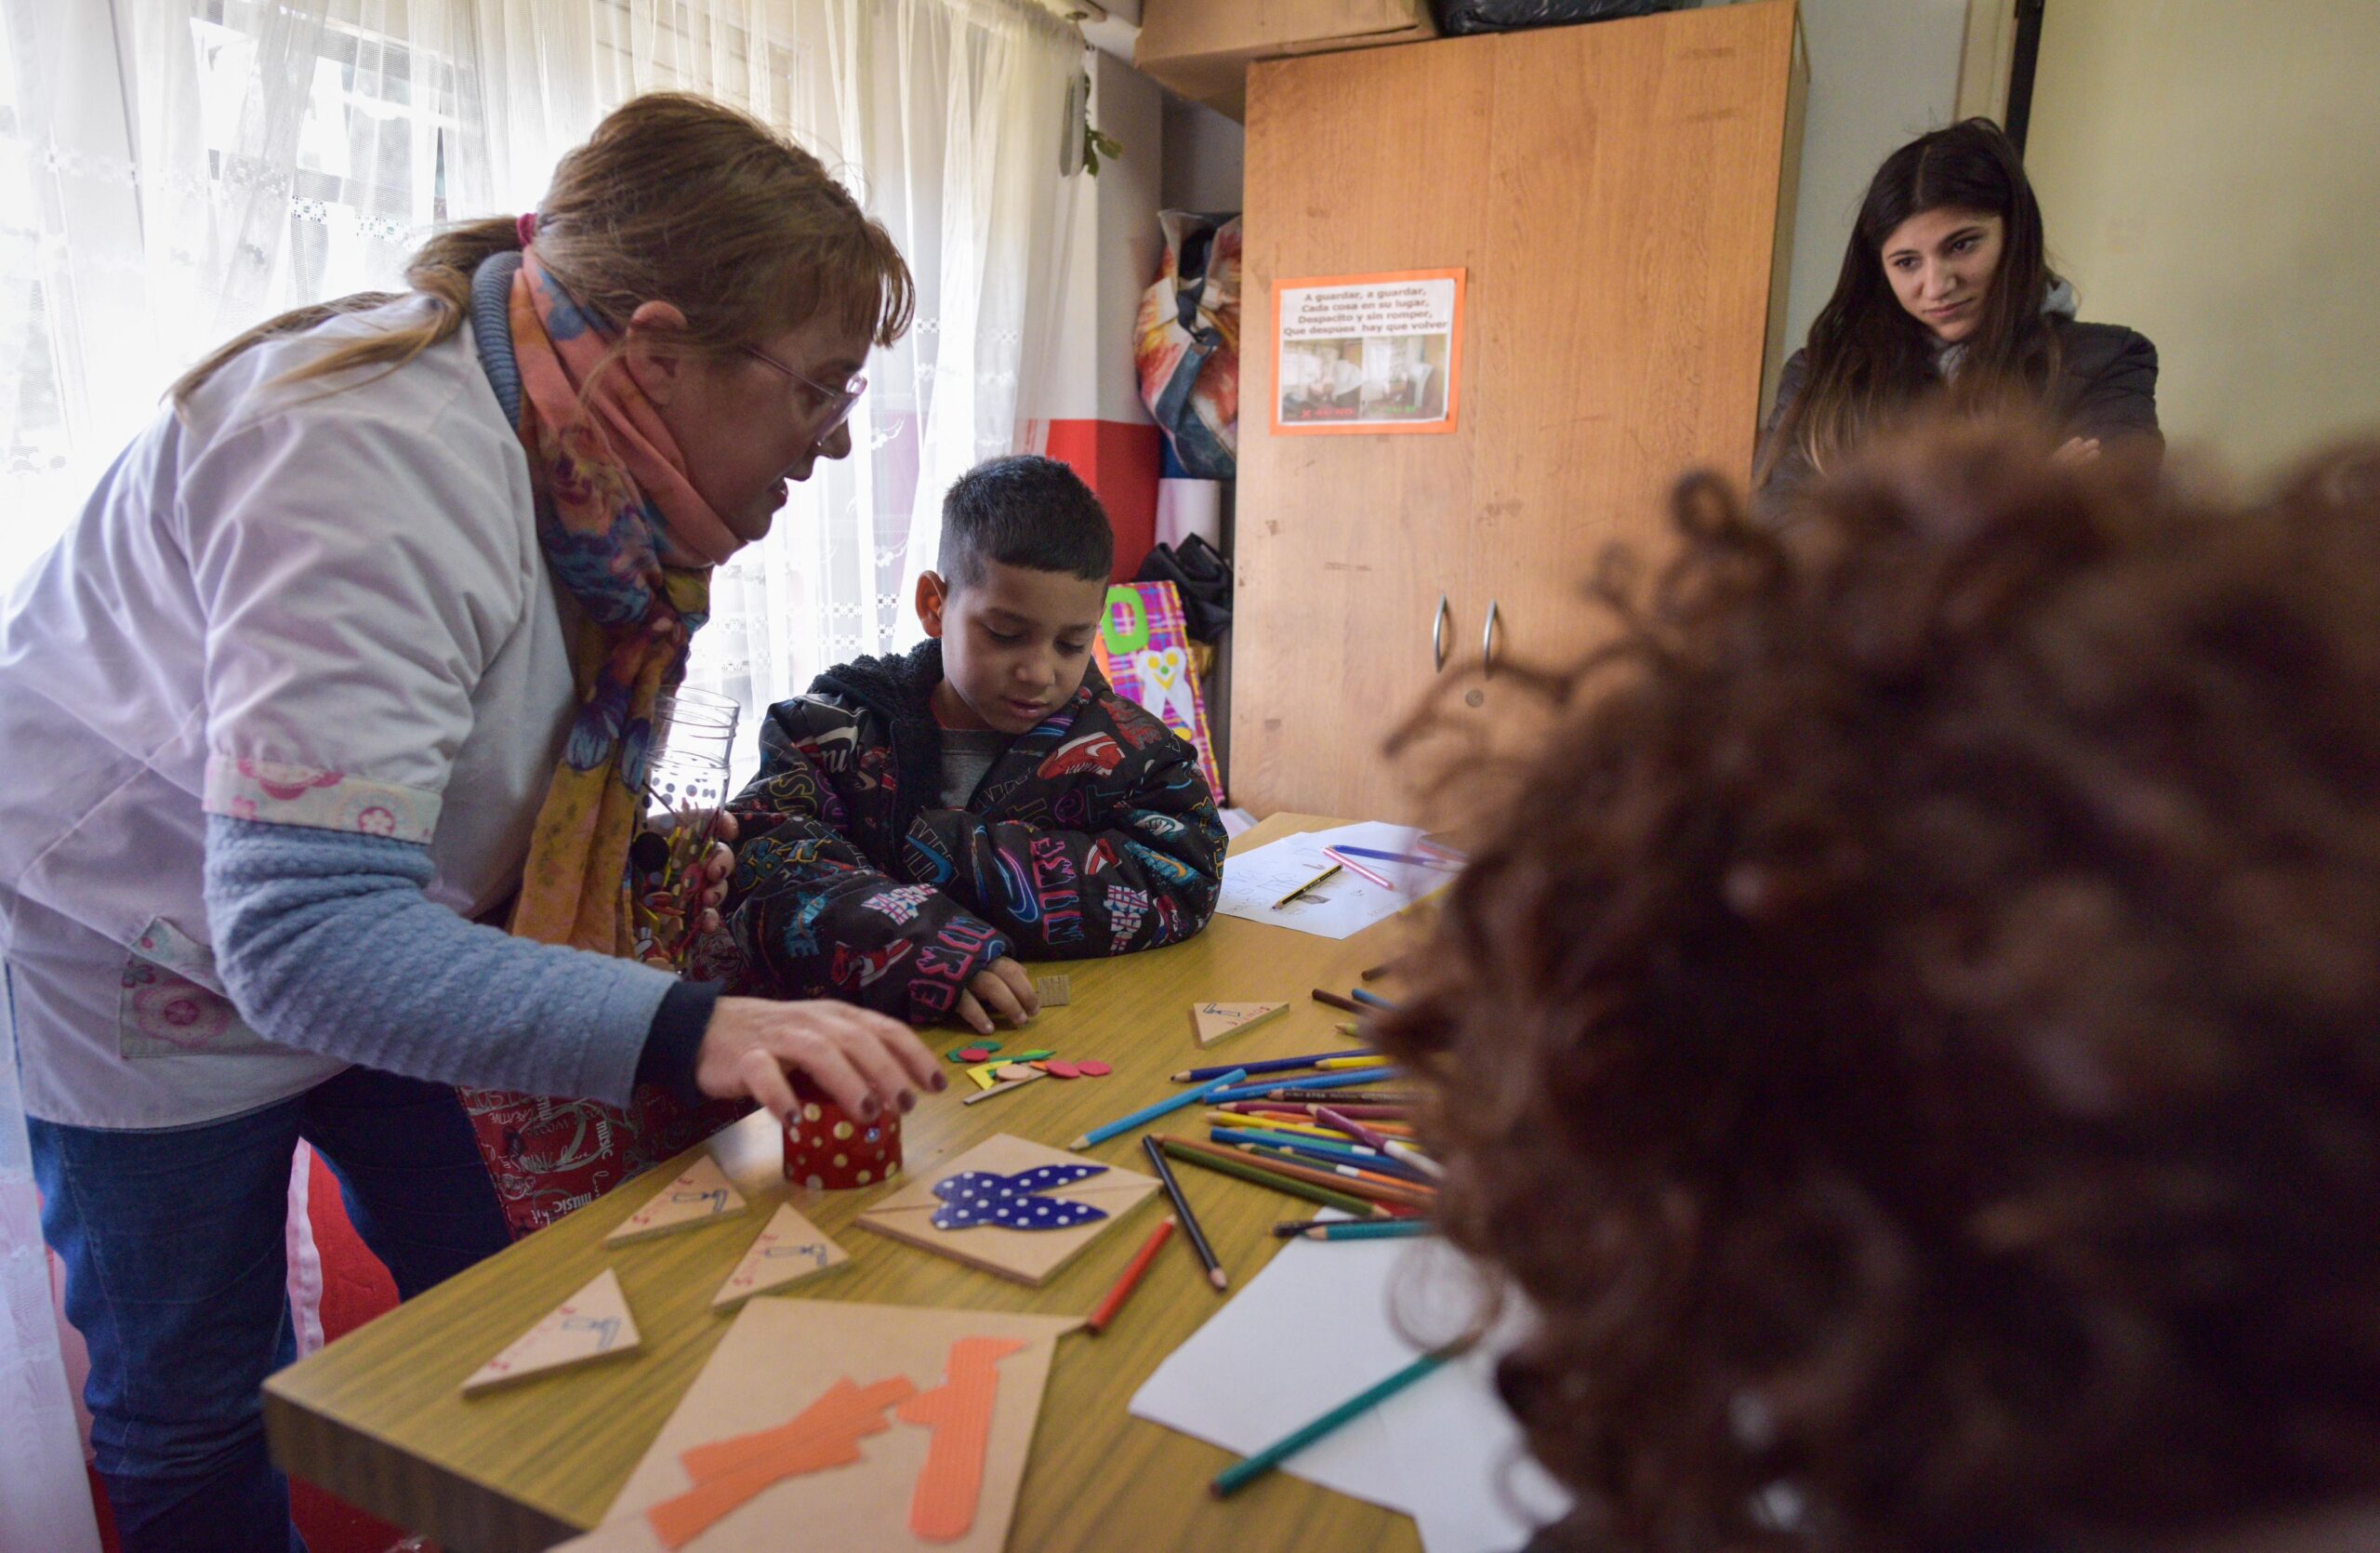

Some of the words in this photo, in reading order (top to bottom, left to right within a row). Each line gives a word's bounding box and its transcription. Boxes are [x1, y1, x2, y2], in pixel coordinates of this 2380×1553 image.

[1304, 294, 1312, 302] A
[1316, 291, 1362, 302] guardar,
[1377, 287, 1426, 299] guardar,
[1302, 304, 1329, 312] Cada
[1395, 299, 1429, 309] lugar,
[1298, 313, 1354, 325] Despacito
[1367, 312, 1383, 321] sin
[1387, 310, 1432, 321] romper,
[1284, 326, 1306, 336] Que
[1362, 324, 1382, 333] hay
[1386, 324, 1408, 332] que
[1411, 320, 1448, 330] volver
[1029, 837, 1085, 945] NIKE
[595, 1120, 614, 1160] music
[552, 1191, 593, 1215] music
